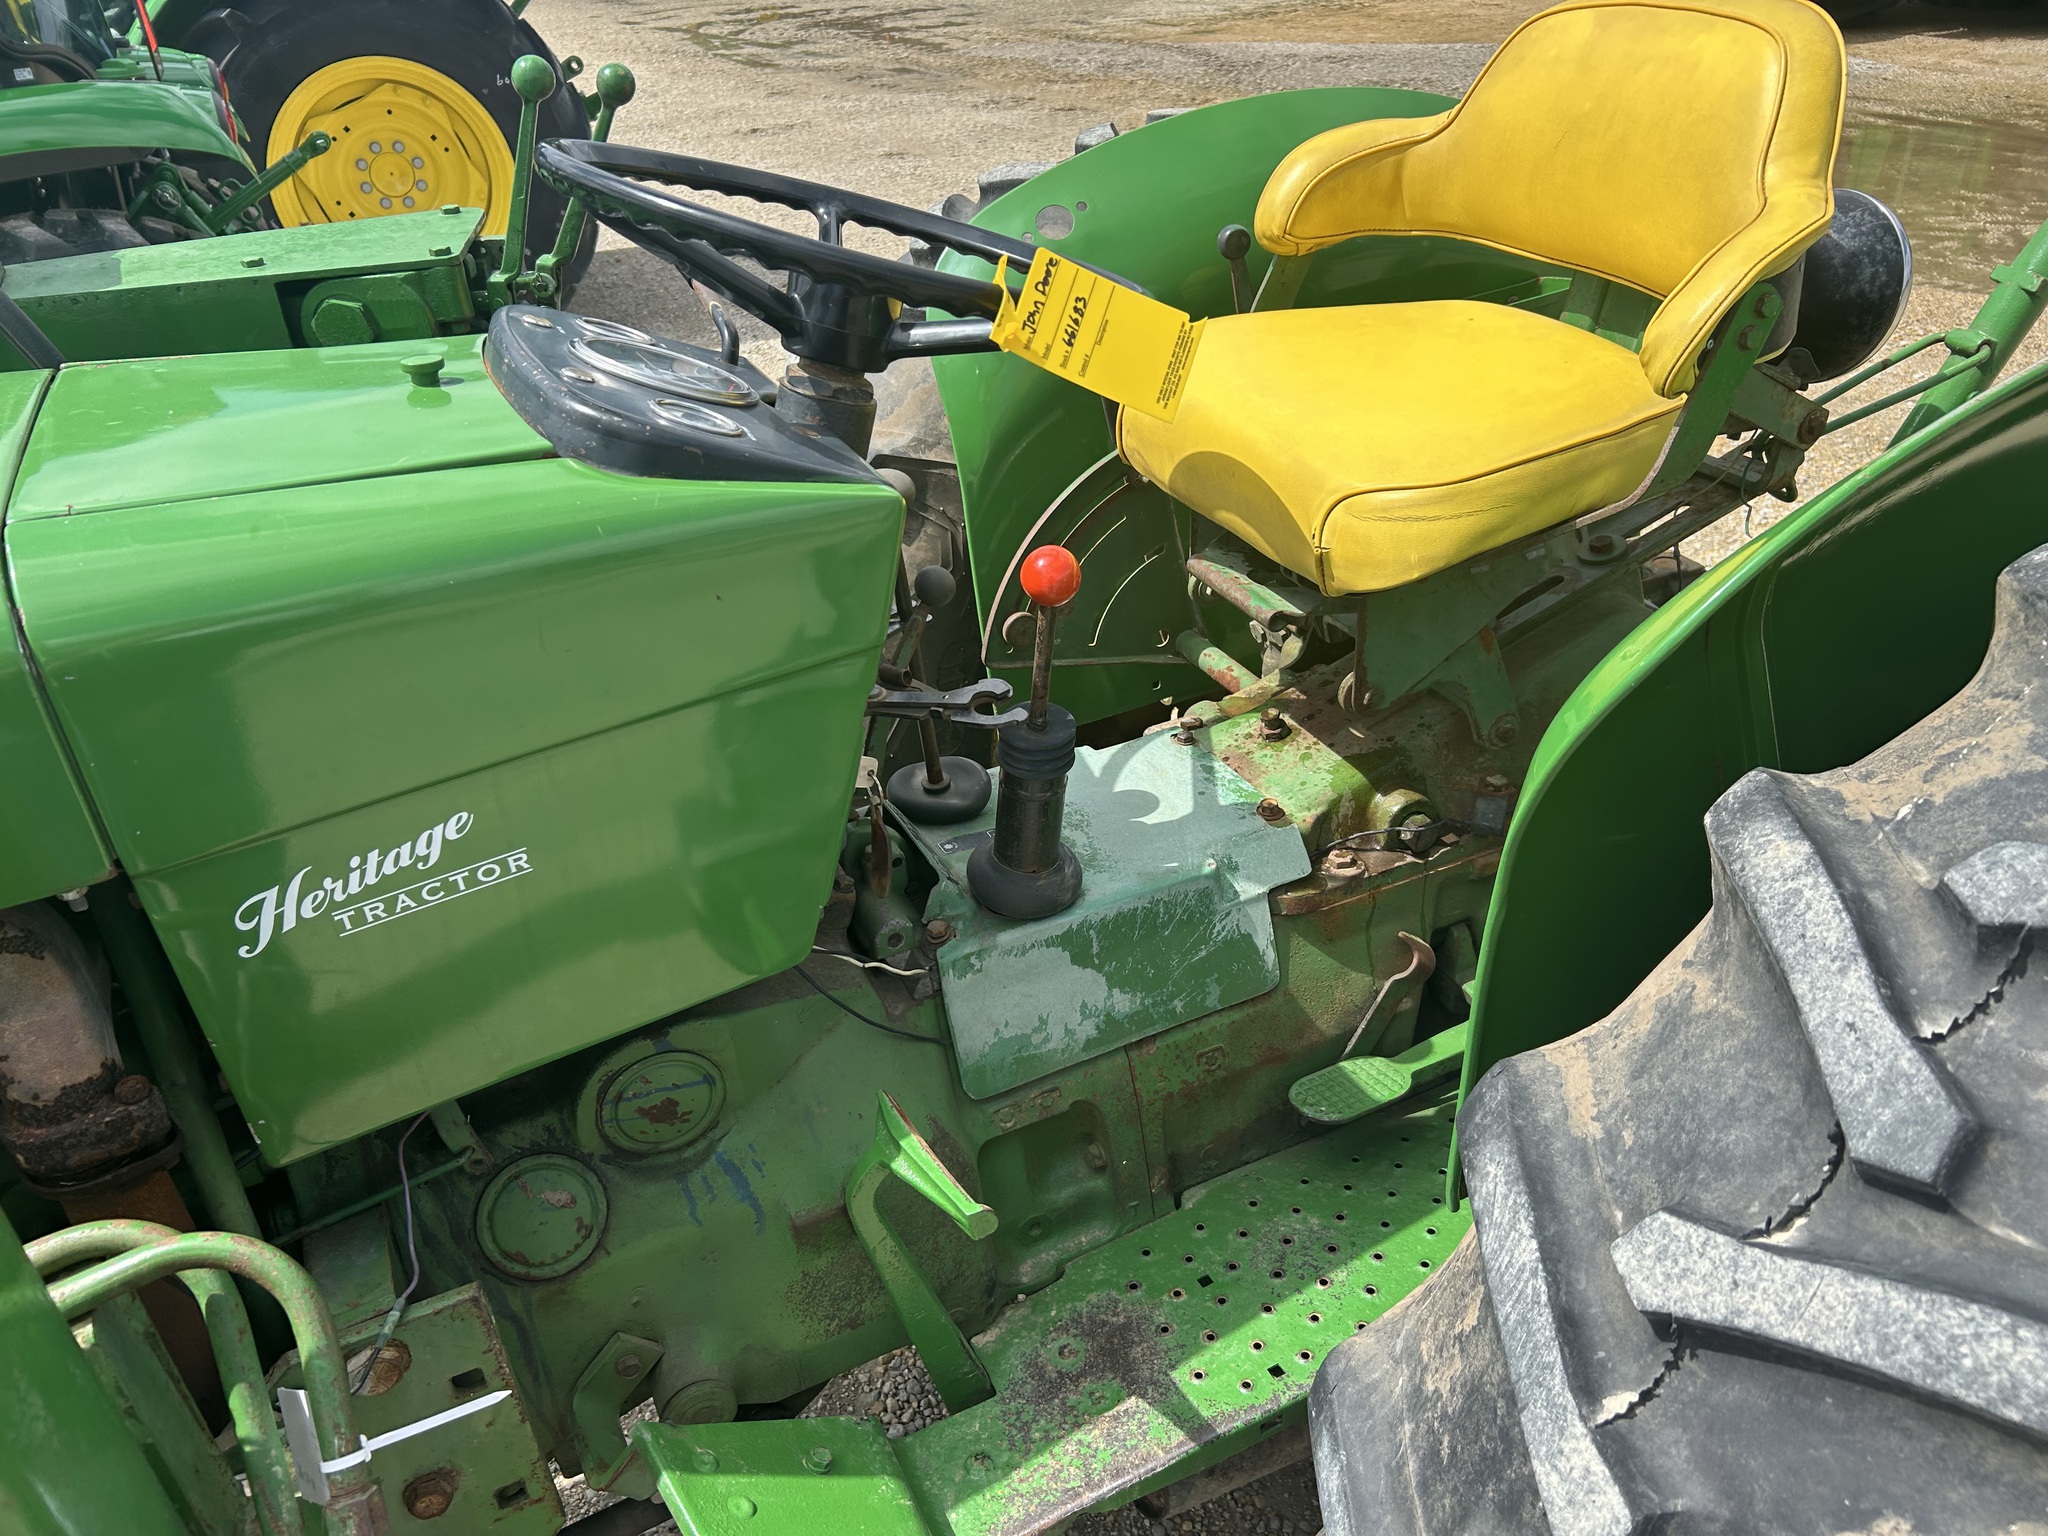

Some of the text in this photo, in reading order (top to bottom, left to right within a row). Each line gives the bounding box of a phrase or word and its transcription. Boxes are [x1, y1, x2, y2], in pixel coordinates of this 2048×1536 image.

[1022, 300, 1045, 334] John
[1062, 296, 1086, 347] 661683
[234, 811, 474, 958] Heritage
[334, 852, 531, 930] TRACTOR
